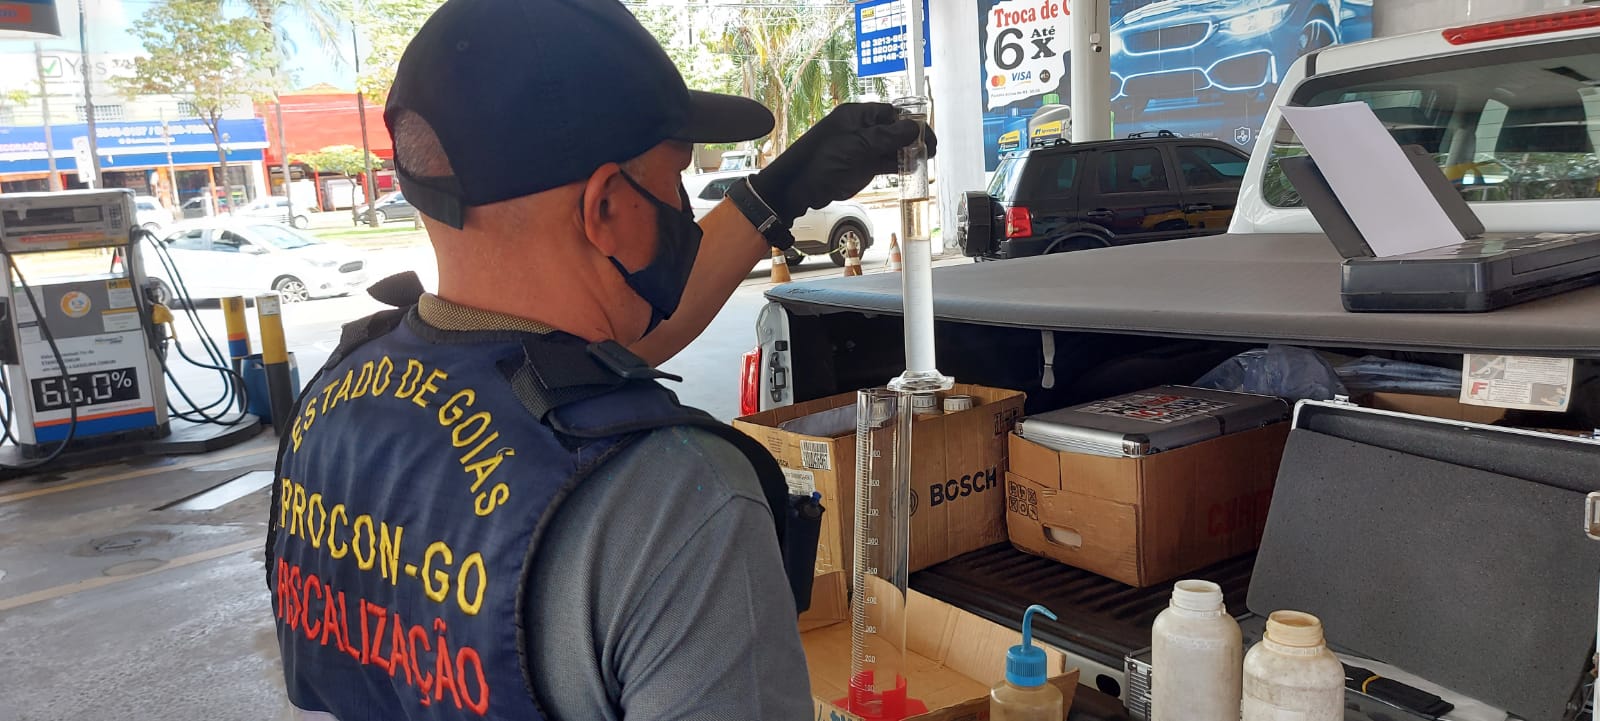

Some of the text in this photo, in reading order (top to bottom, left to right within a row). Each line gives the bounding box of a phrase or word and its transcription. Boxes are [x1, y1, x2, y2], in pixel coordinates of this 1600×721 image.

[993, 7, 1036, 28] Troca
[1040, 3, 1058, 21] de
[1031, 25, 1057, 39] Até
[993, 28, 1024, 70] 6
[1011, 70, 1032, 82] VISA
[290, 355, 516, 517] ESTADO DE GOIÁS
[930, 465, 997, 507] BOSCH
[279, 478, 488, 615] PROCON-GO
[277, 556, 490, 716] FISCALIZAÇÃO
